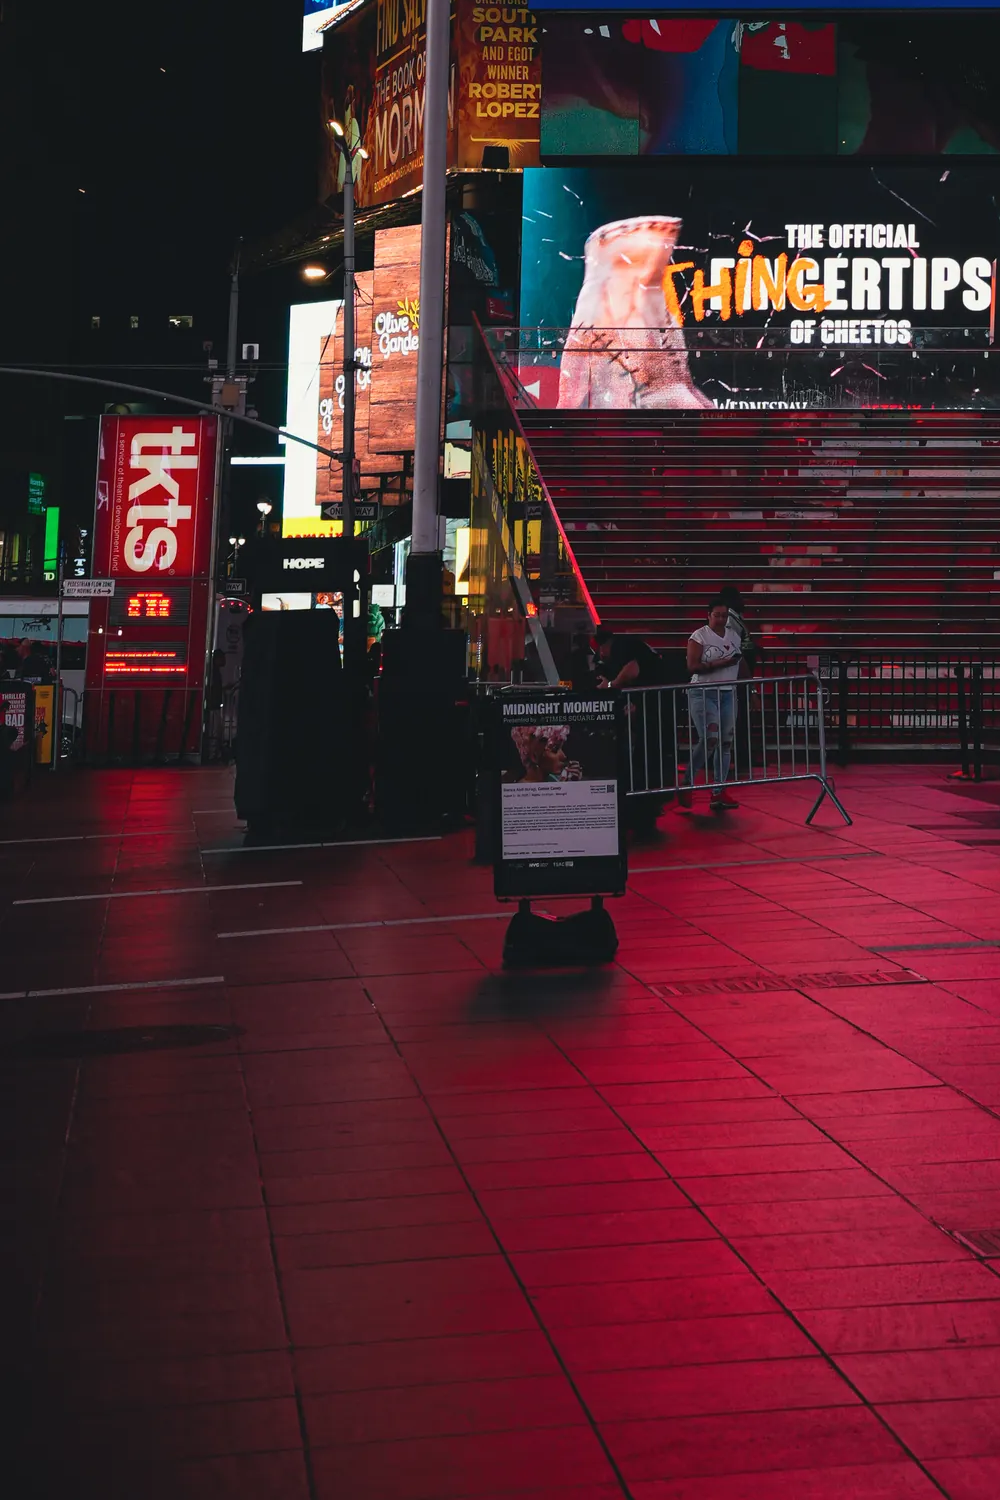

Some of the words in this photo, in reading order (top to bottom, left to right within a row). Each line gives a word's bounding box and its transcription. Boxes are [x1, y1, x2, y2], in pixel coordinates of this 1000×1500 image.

[480, 26, 538, 43] PARK
[482, 46, 504, 61] AND
[508, 46, 534, 61] EGOT
[487, 65, 530, 80] WINNER
[376, 69, 391, 108] THE
[392, 57, 415, 91] BOOK
[468, 83, 542, 99] ROBERT
[476, 101, 540, 118] LOPEZ
[785, 223, 824, 248] THE
[828, 223, 919, 248] OFFICIAL
[375, 311, 409, 335] Olive
[790, 320, 815, 344] OF
[820, 319, 911, 344] CHEETOS
[117, 440, 126, 466] service
[115, 477, 124, 503] theatre
[124, 426, 198, 573] tkts
[356, 507, 372, 516] WAY
[112, 505, 123, 553] development
[111, 554, 119, 572] fund
[283, 558, 325, 570] HOPE
[44, 572, 55, 581] TD
[503, 702, 560, 715] MIDNIGHT
[563, 701, 615, 713] MOMENT
[5, 714, 24, 727] BAD
[568, 714, 595, 722] SQUARE
